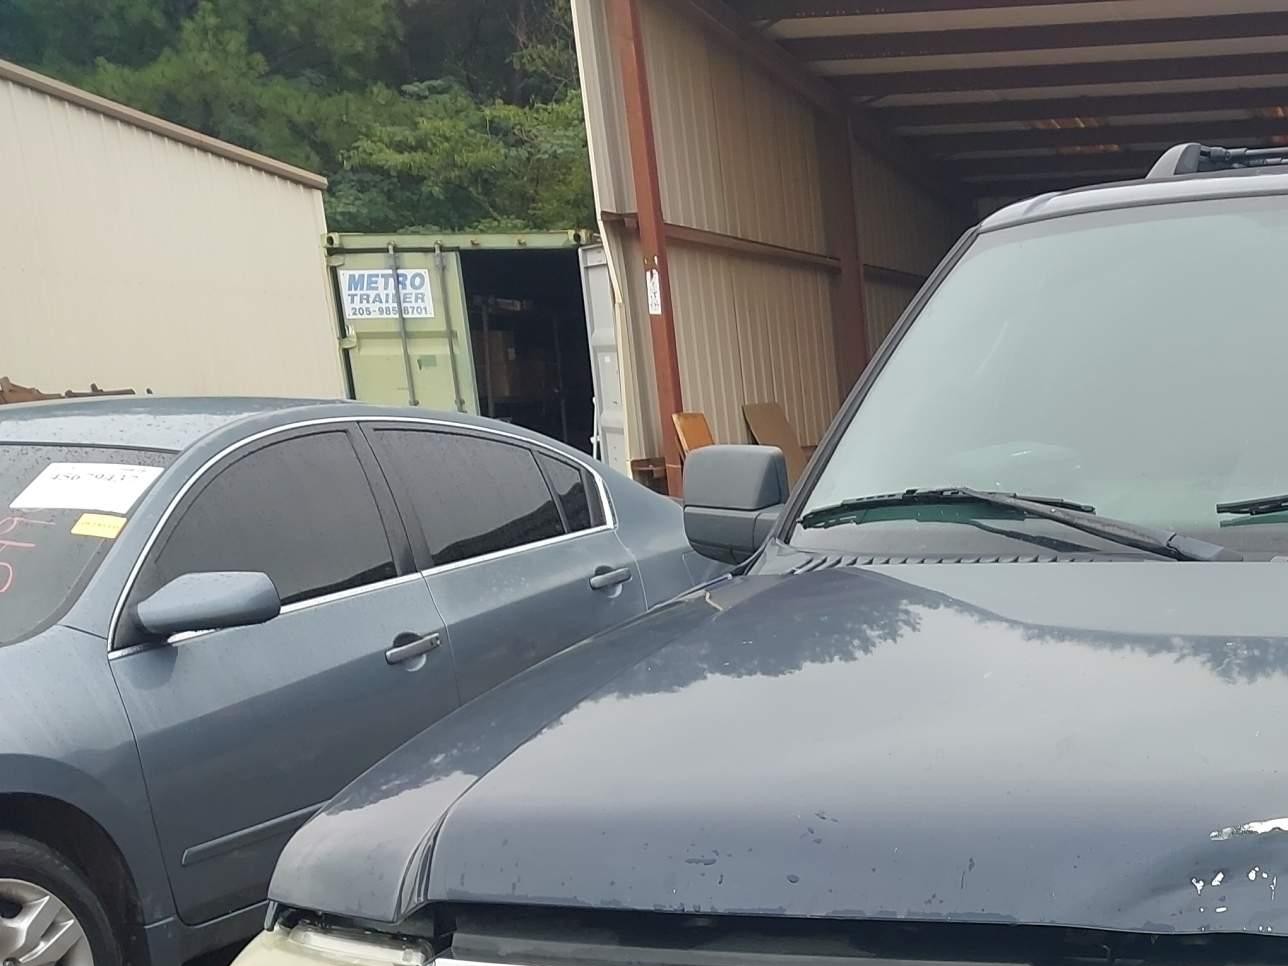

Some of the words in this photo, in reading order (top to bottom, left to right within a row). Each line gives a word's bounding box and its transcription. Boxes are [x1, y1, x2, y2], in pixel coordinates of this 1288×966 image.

[347, 272, 426, 291] METRO
[347, 292, 426, 304] TRAILER
[351, 306, 428, 316] 205-9858701
